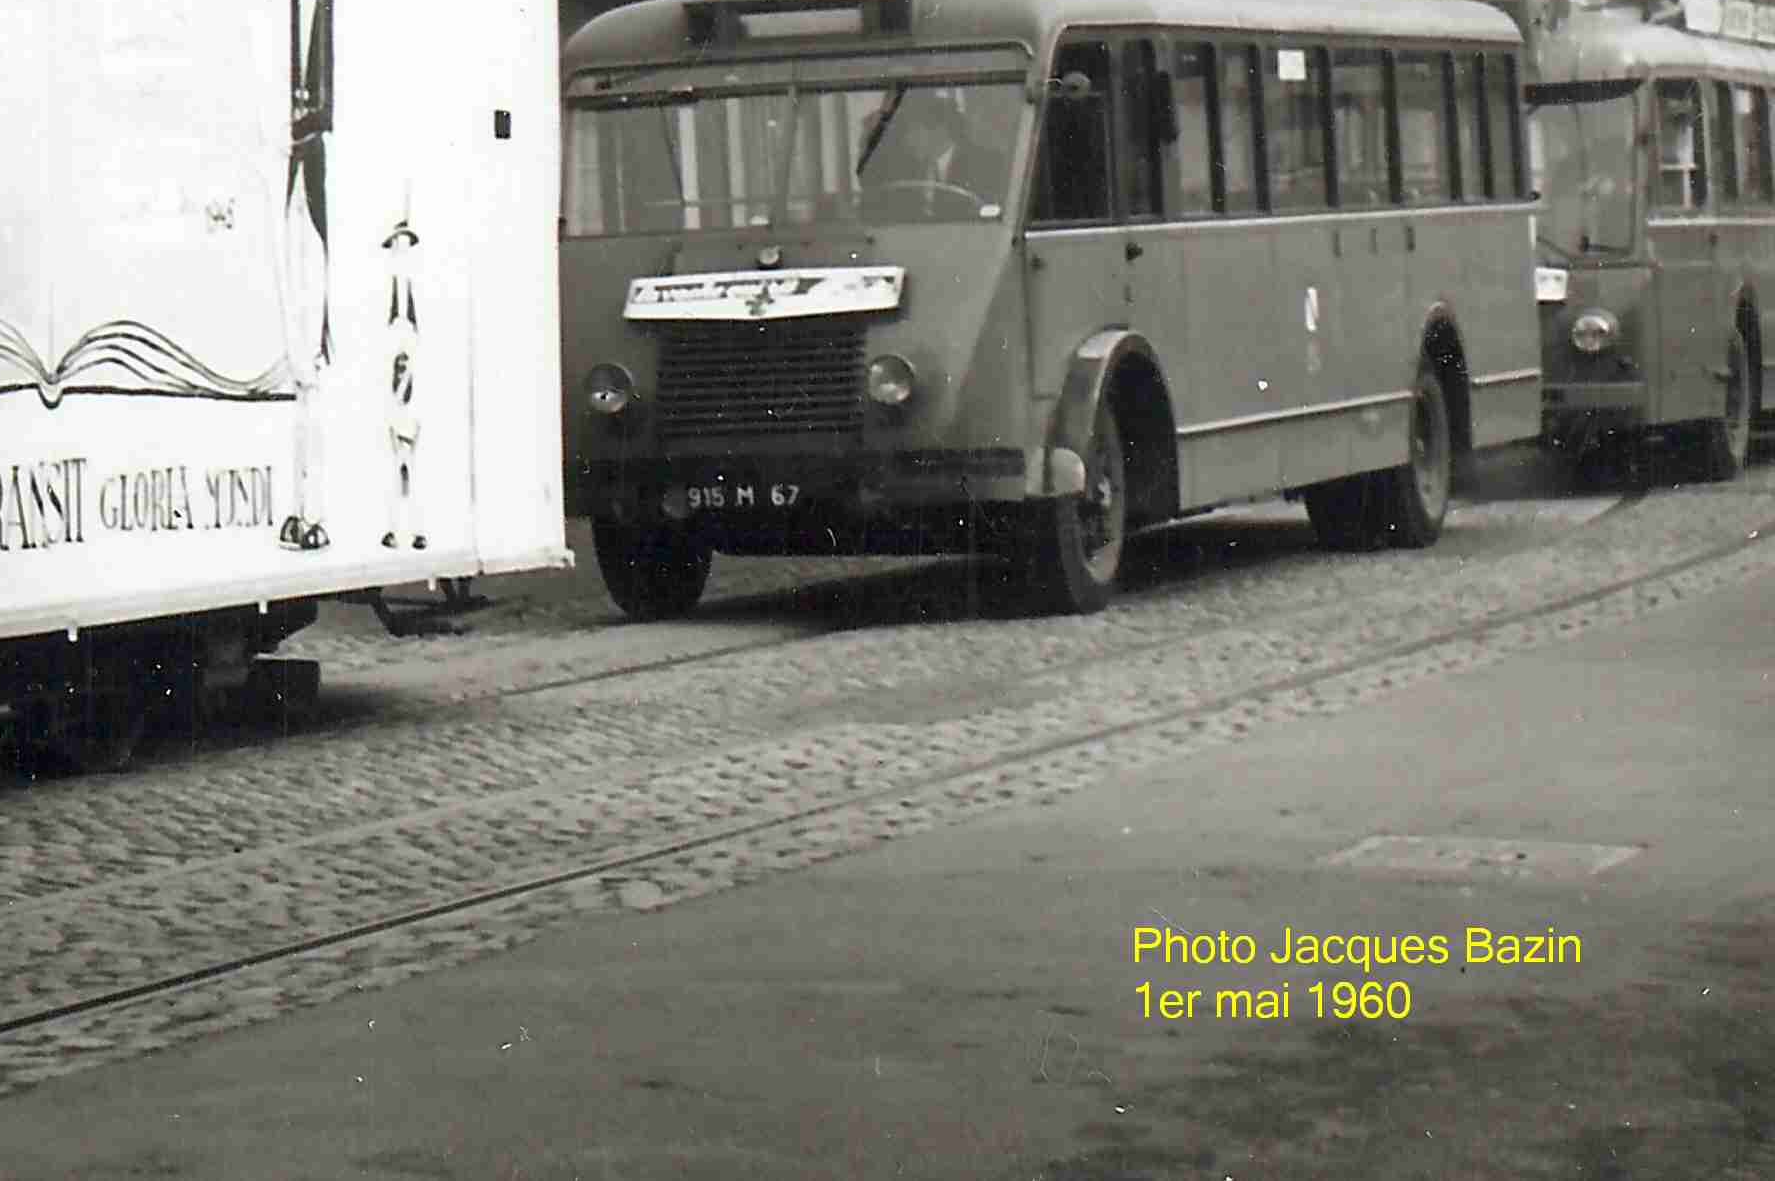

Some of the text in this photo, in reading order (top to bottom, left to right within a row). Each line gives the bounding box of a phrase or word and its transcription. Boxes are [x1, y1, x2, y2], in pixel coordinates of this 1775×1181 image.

[98, 465, 194, 533] GLORIA
[687, 486, 726, 508] 915
[770, 484, 800, 506] 67
